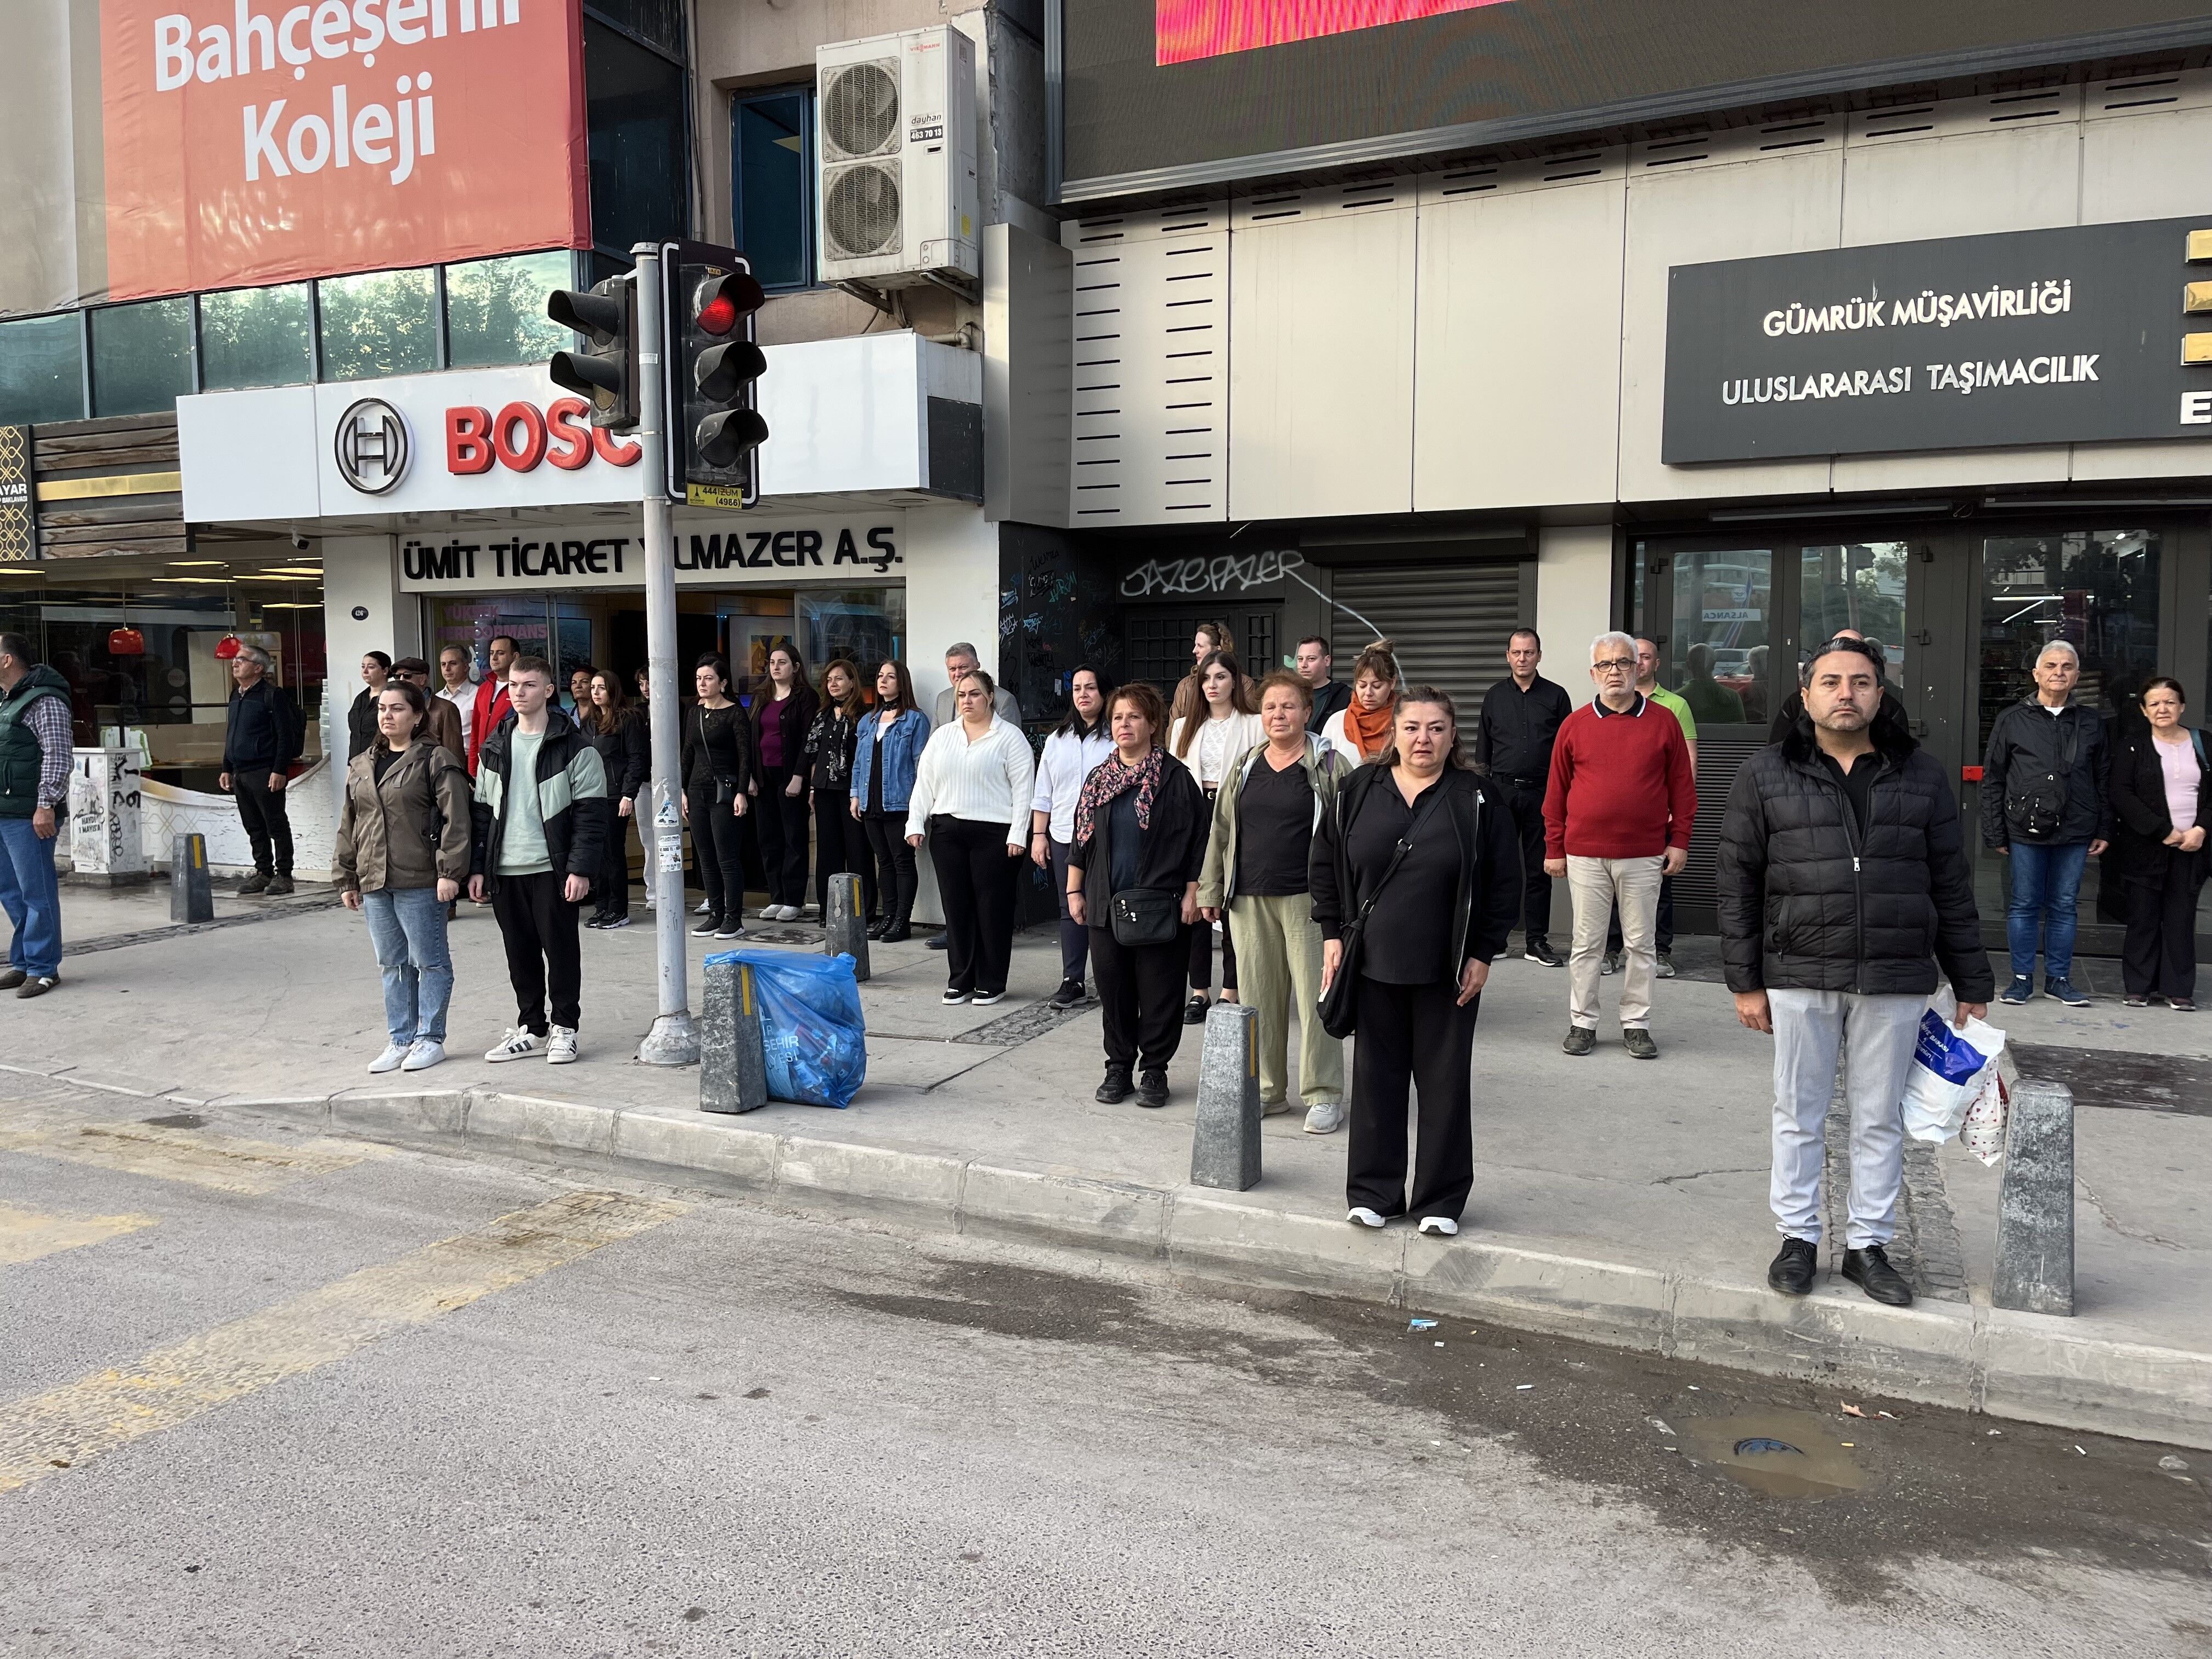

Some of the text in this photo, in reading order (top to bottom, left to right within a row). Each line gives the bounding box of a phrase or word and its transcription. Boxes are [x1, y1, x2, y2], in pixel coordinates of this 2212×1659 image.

[242, 71, 435, 185] Koleji
[911, 114, 941, 125] dayhan
[911, 128, 942, 140] 463 70 13
[1763, 279, 2071, 337] GÜMRÜK MÜŞAVİRLİĞİ
[1722, 354, 2100, 405] ULUSLARARASI TAŞIMACILIK
[445, 397, 642, 475] BOSC
[716, 496, 741, 507] (4986)
[403, 527, 903, 579] ÜMİT TİCARET LMAZER A.Ş.
